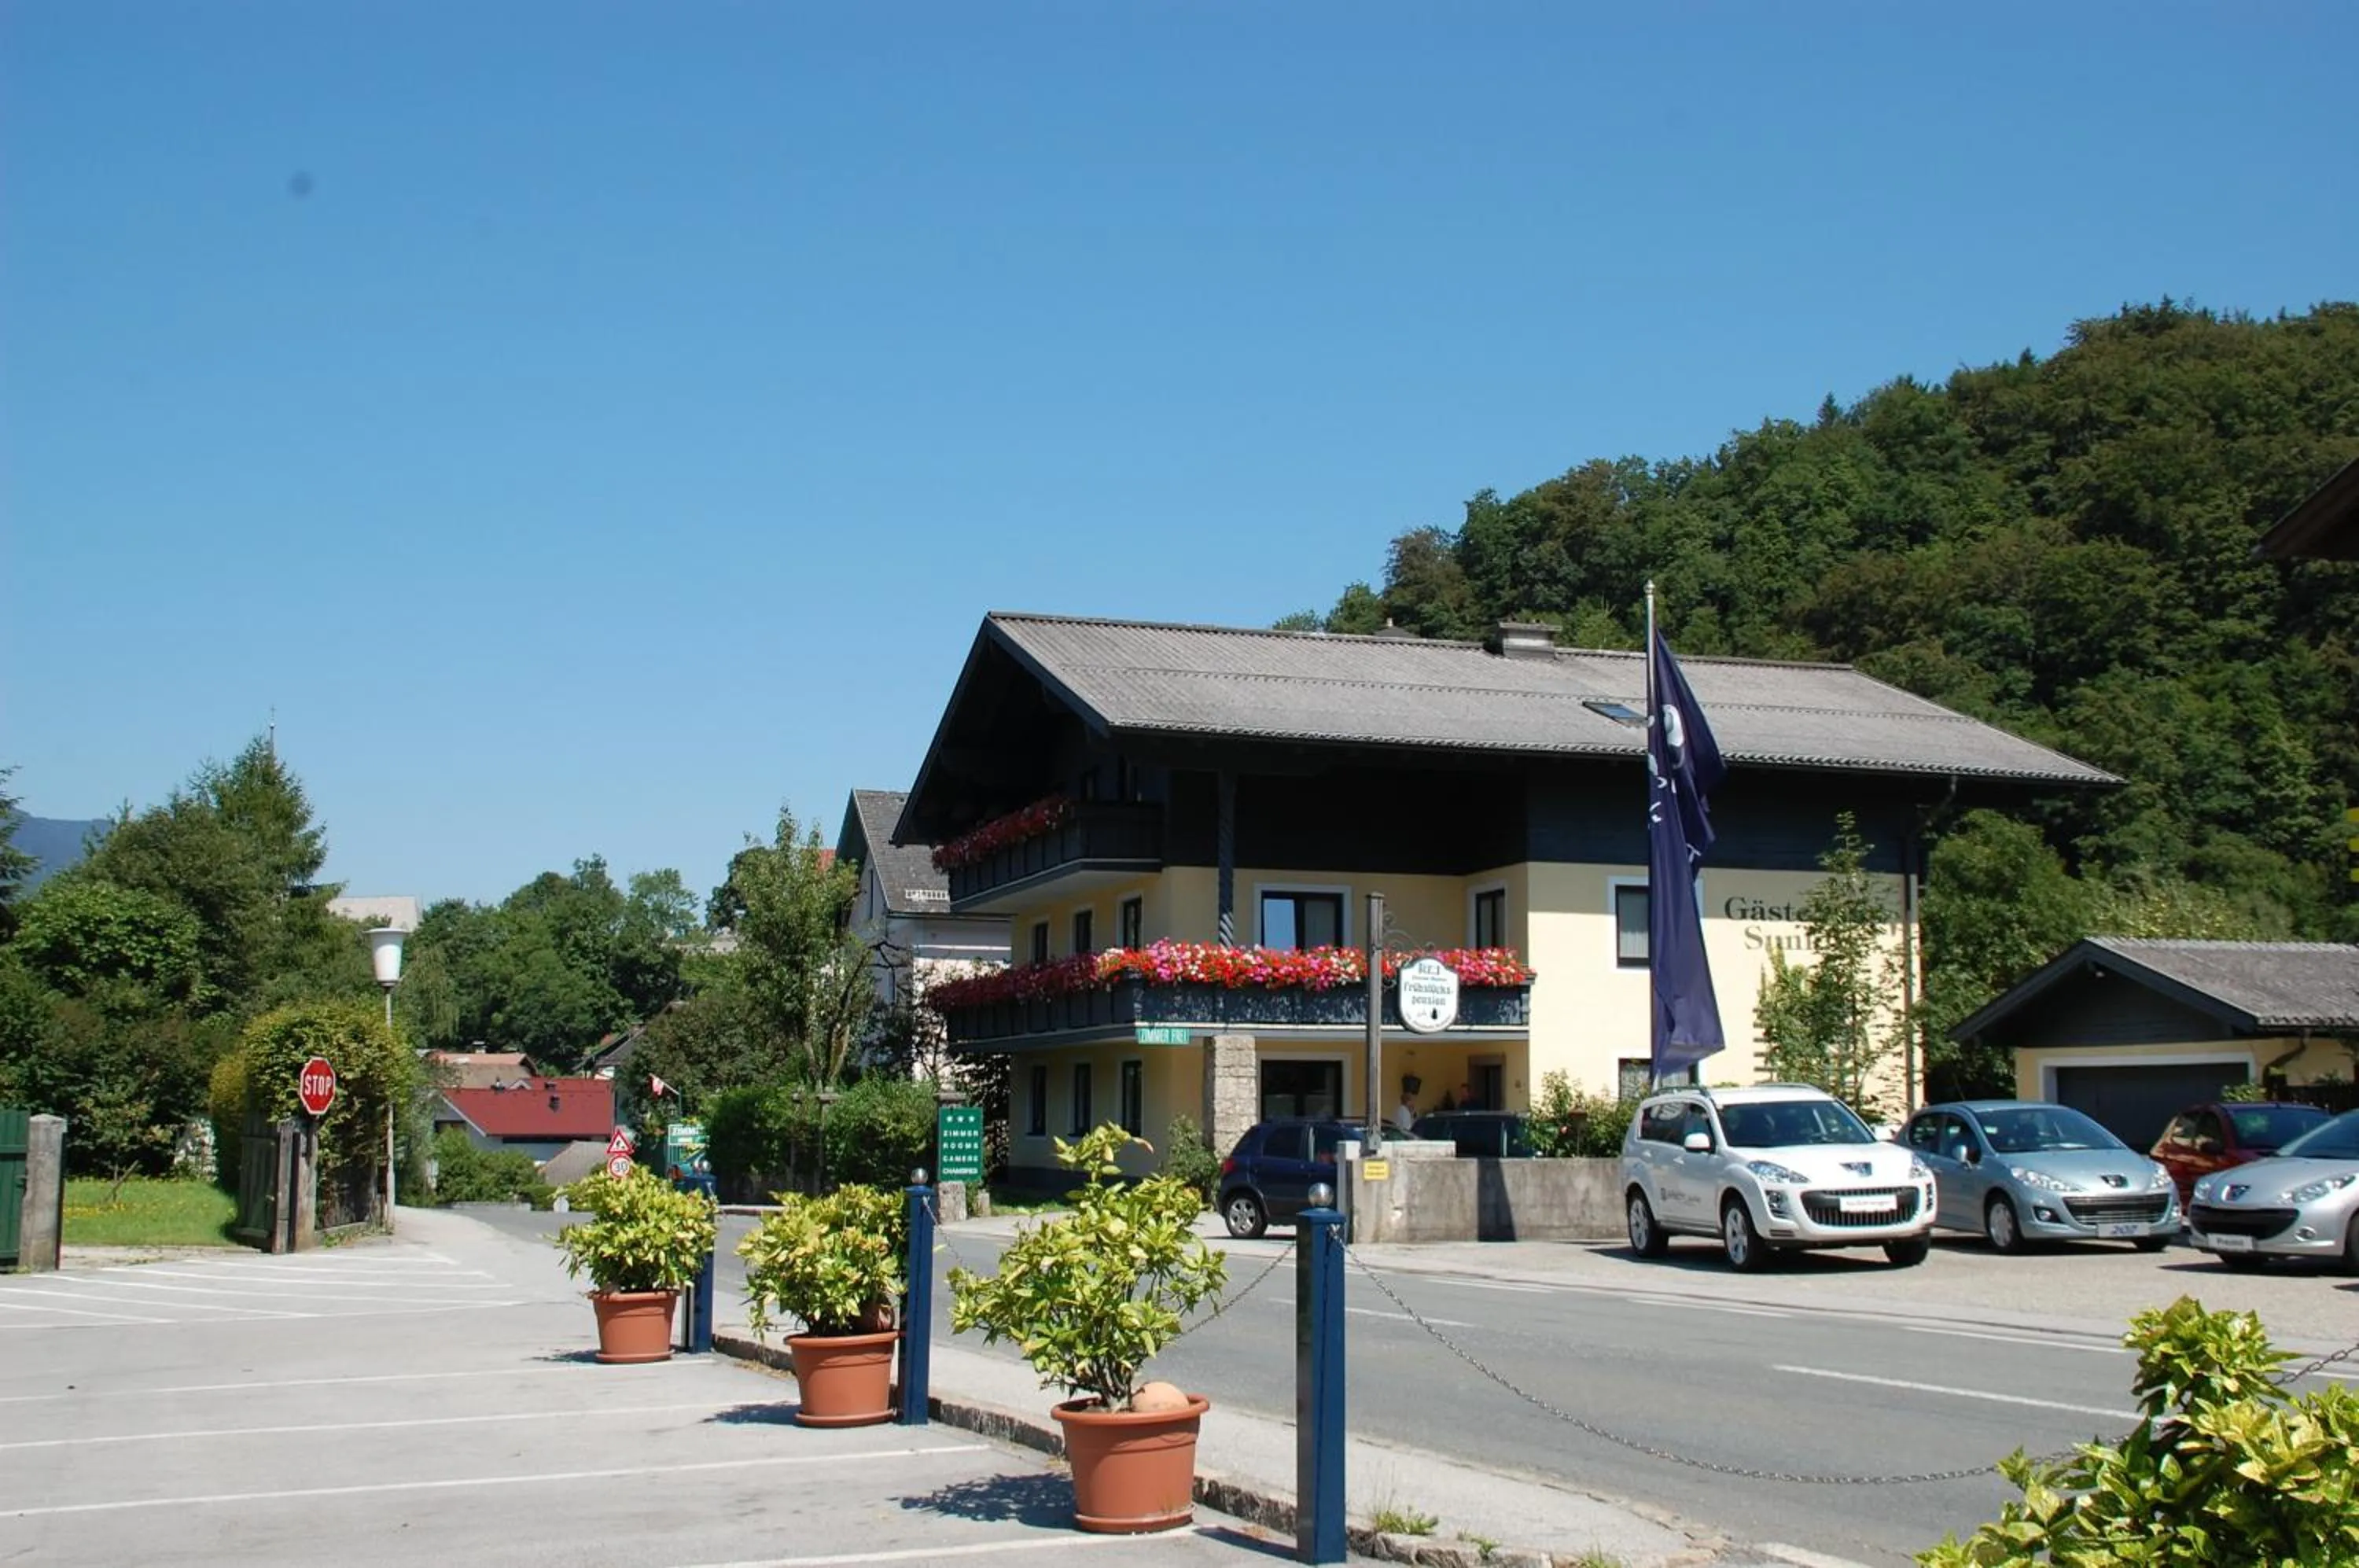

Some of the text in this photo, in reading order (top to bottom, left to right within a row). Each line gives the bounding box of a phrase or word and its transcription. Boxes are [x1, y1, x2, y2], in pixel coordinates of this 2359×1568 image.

[1724, 896, 1810, 922] Gäste
[1139, 1028, 1168, 1043] ZIMMER
[304, 1073, 333, 1096] STOP
[943, 1129, 979, 1138] ZIMMER
[614, 1161, 628, 1170] 30
